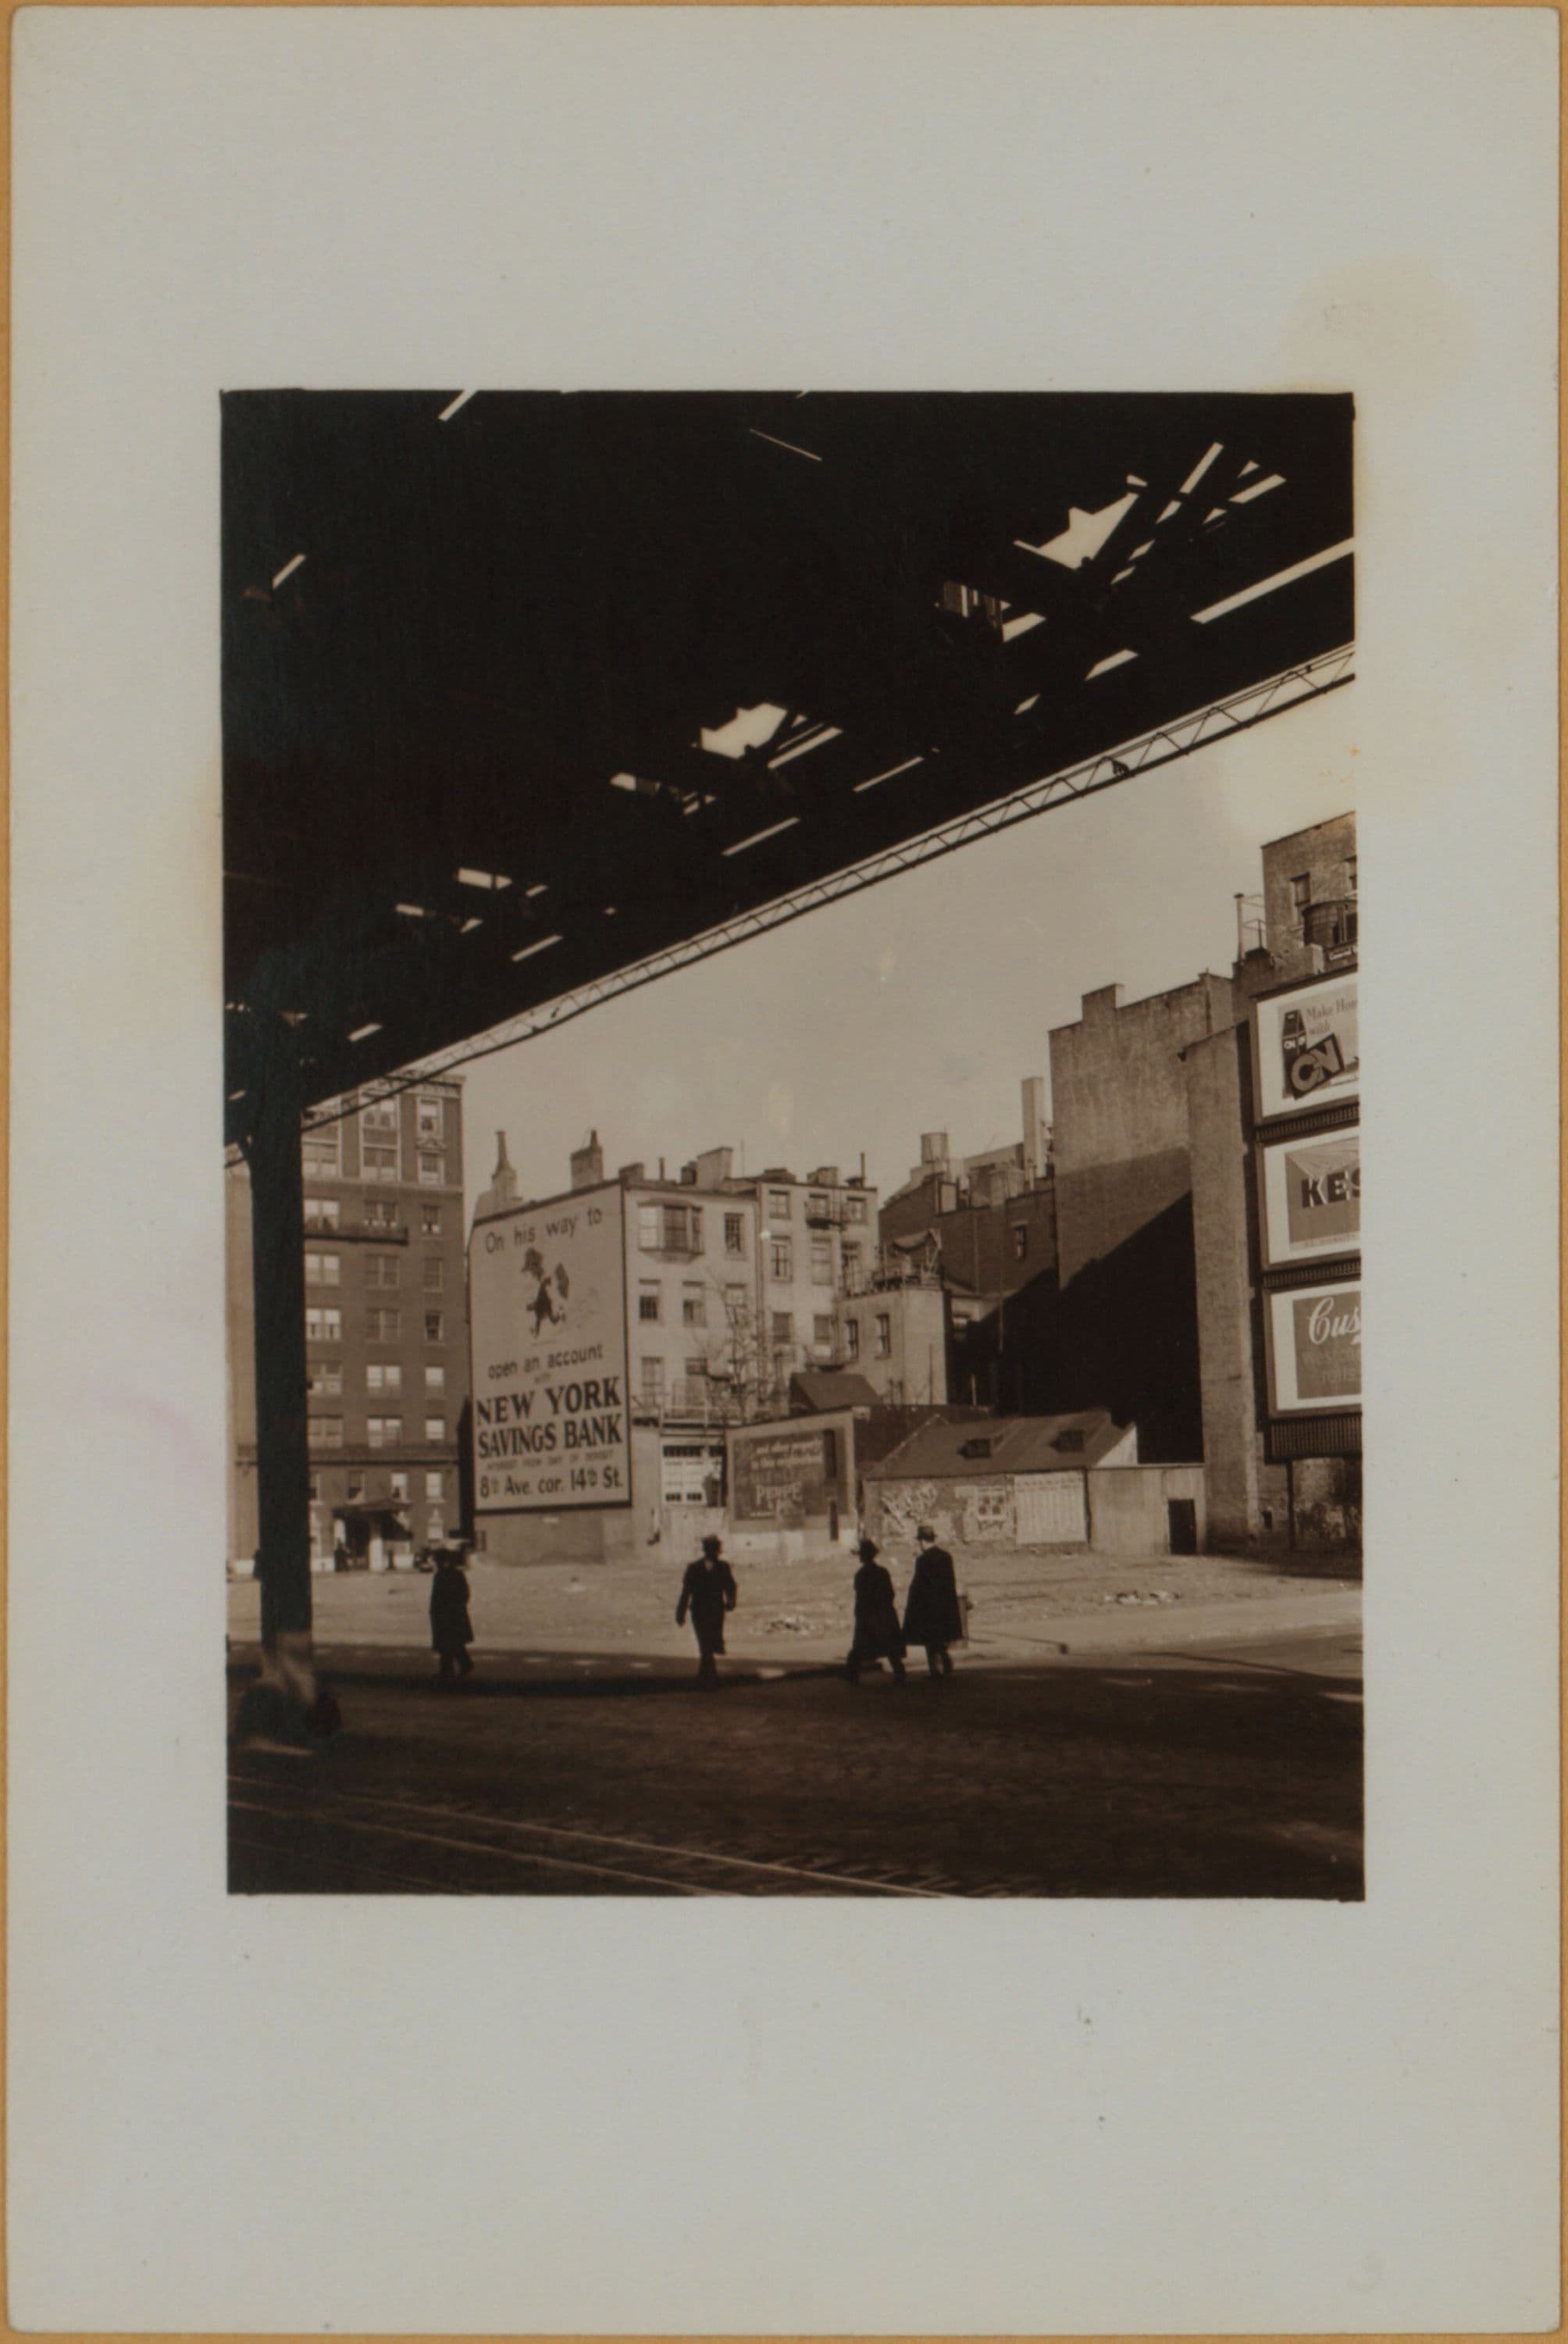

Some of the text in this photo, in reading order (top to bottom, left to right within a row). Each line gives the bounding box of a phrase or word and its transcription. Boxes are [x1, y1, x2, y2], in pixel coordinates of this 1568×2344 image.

[486, 1207, 602, 1253] On his way to
[488, 1343, 603, 1380] open an account
[476, 1375, 622, 1425] NEW YORK
[479, 1413, 622, 1459] SAVINGS BANK
